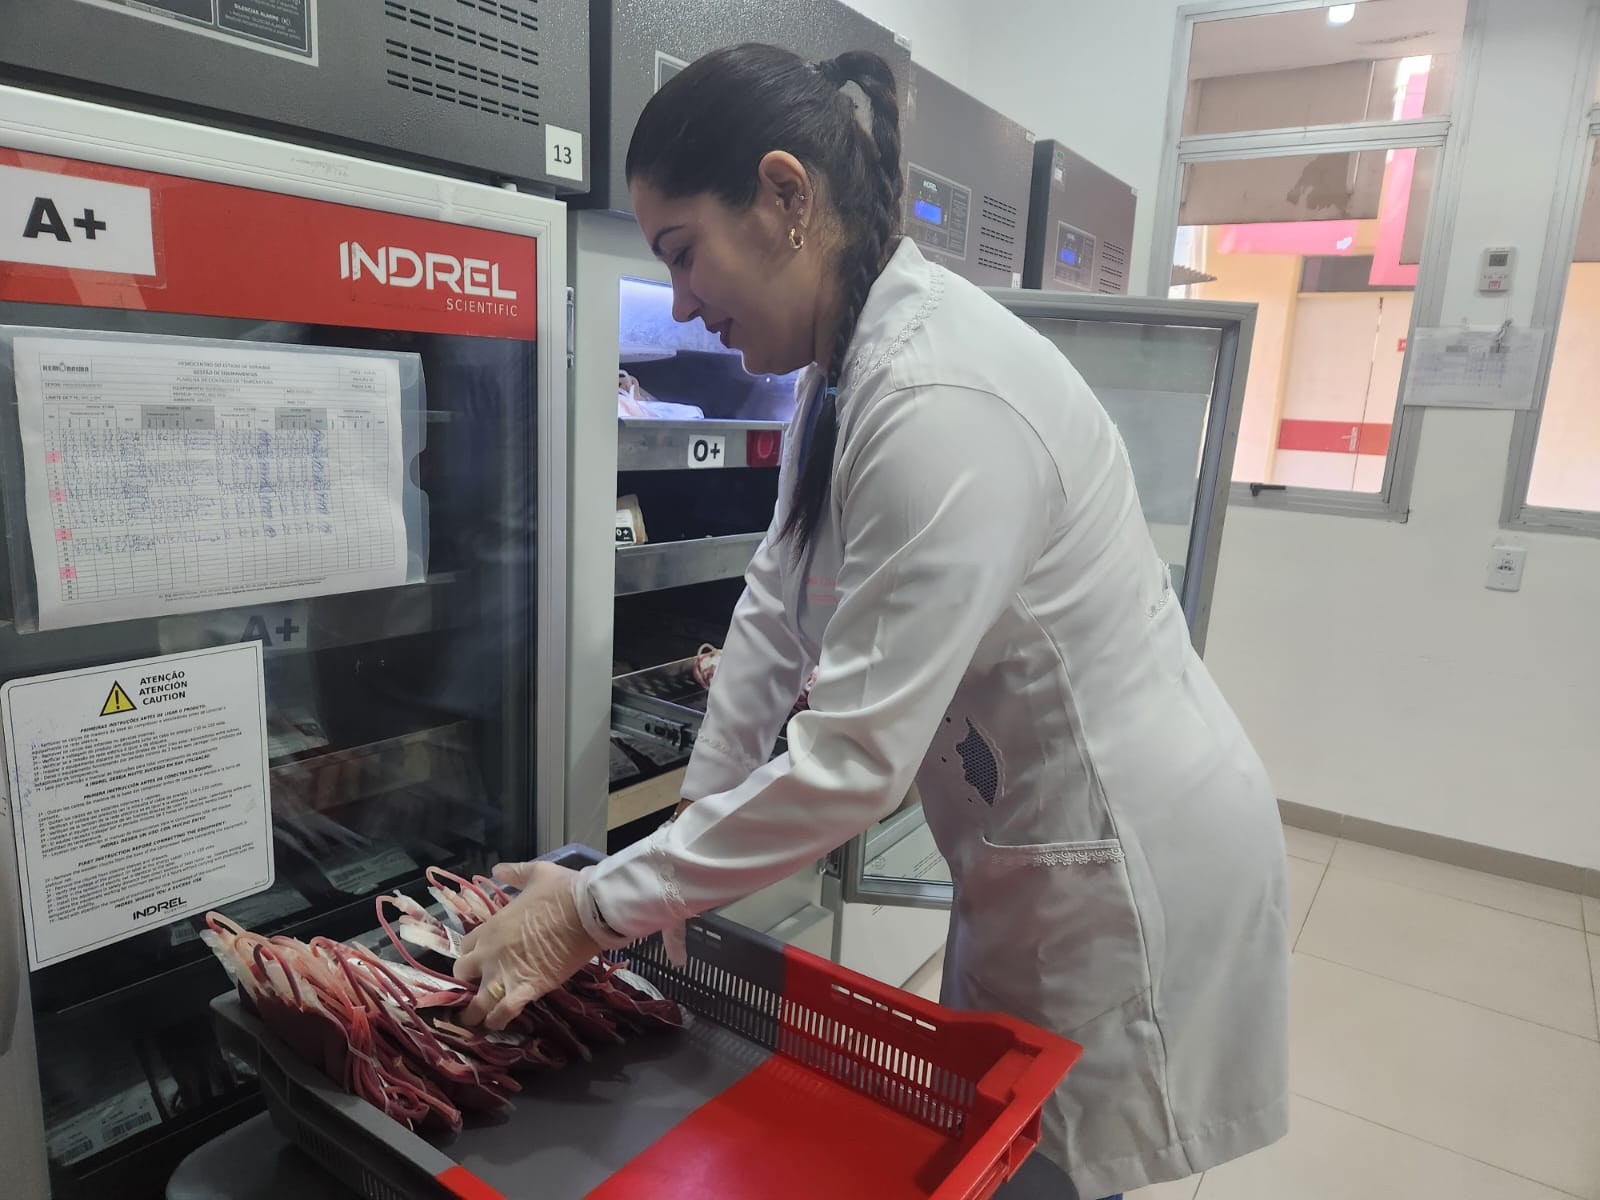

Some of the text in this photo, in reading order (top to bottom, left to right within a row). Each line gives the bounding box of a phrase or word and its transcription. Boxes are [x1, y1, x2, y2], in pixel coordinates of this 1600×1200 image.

[553, 144, 573, 164] 13
[22, 196, 107, 243] A+
[339, 241, 517, 300] INDREL
[446, 298, 518, 316] SCIENTIFIC
[241, 615, 300, 646] A+
[140, 670, 184, 685] ATENÇÃO
[139, 681, 187, 696] ATENCIÓN
[142, 690, 186, 705] CAUTION
[133, 896, 187, 920] INDREL
